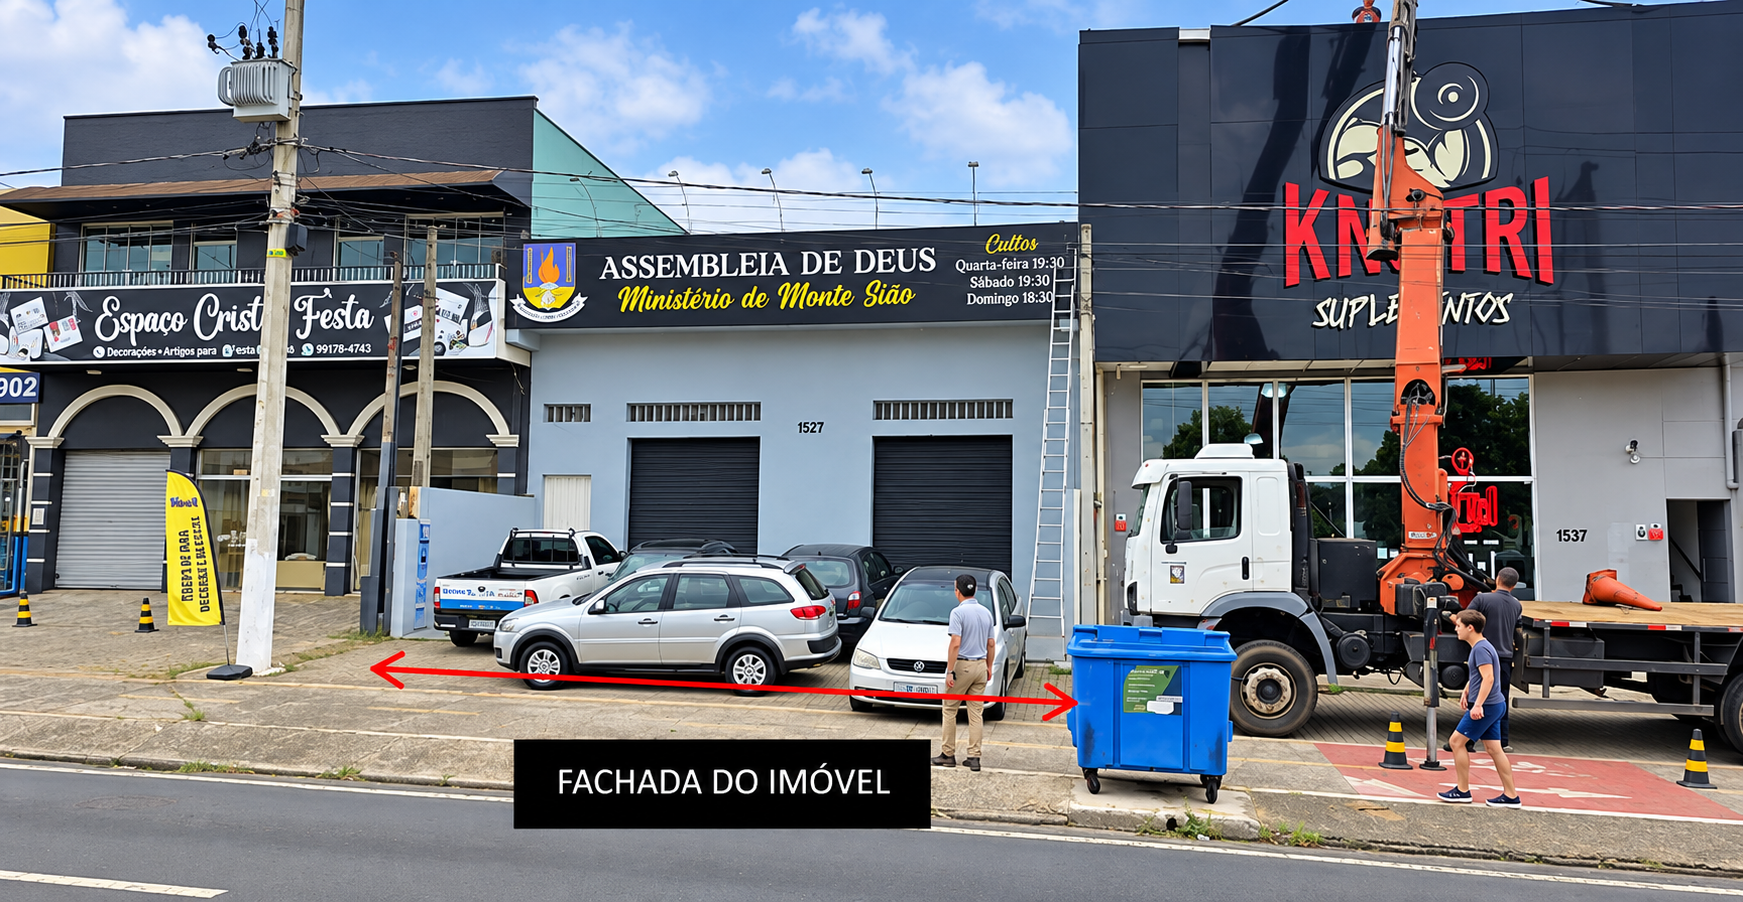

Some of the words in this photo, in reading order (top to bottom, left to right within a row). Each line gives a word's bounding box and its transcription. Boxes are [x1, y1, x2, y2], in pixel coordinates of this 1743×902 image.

[1285, 176, 1554, 287] KNTRI
[985, 233, 1039, 255] Cultos
[599, 252, 790, 280] ASSEMBLEIA
[800, 250, 843, 275] DE
[853, 247, 937, 273] DEUS
[955, 258, 1029, 274] Quarta-feira
[1032, 256, 1065, 269] 19:30
[969, 275, 1015, 289] Sábado
[1018, 274, 1050, 287] 19:30
[617, 285, 735, 313] Ministério
[741, 286, 770, 309] de
[777, 282, 855, 310] Monte
[863, 279, 917, 308] Sião
[966, 292, 1020, 307] Domingo
[1022, 291, 1053, 304] 18:30
[94, 295, 188, 347] Espaço
[193, 293, 264, 341] Crist
[293, 287, 375, 340] Festa
[1312, 291, 1514, 329] SUPLENTOS
[162, 346, 196, 358] Artigos
[196, 347, 217, 358] para
[315, 343, 372, 354] 99178-4743
[797, 421, 825, 434] 1527
[1556, 529, 1588, 543] 1537
